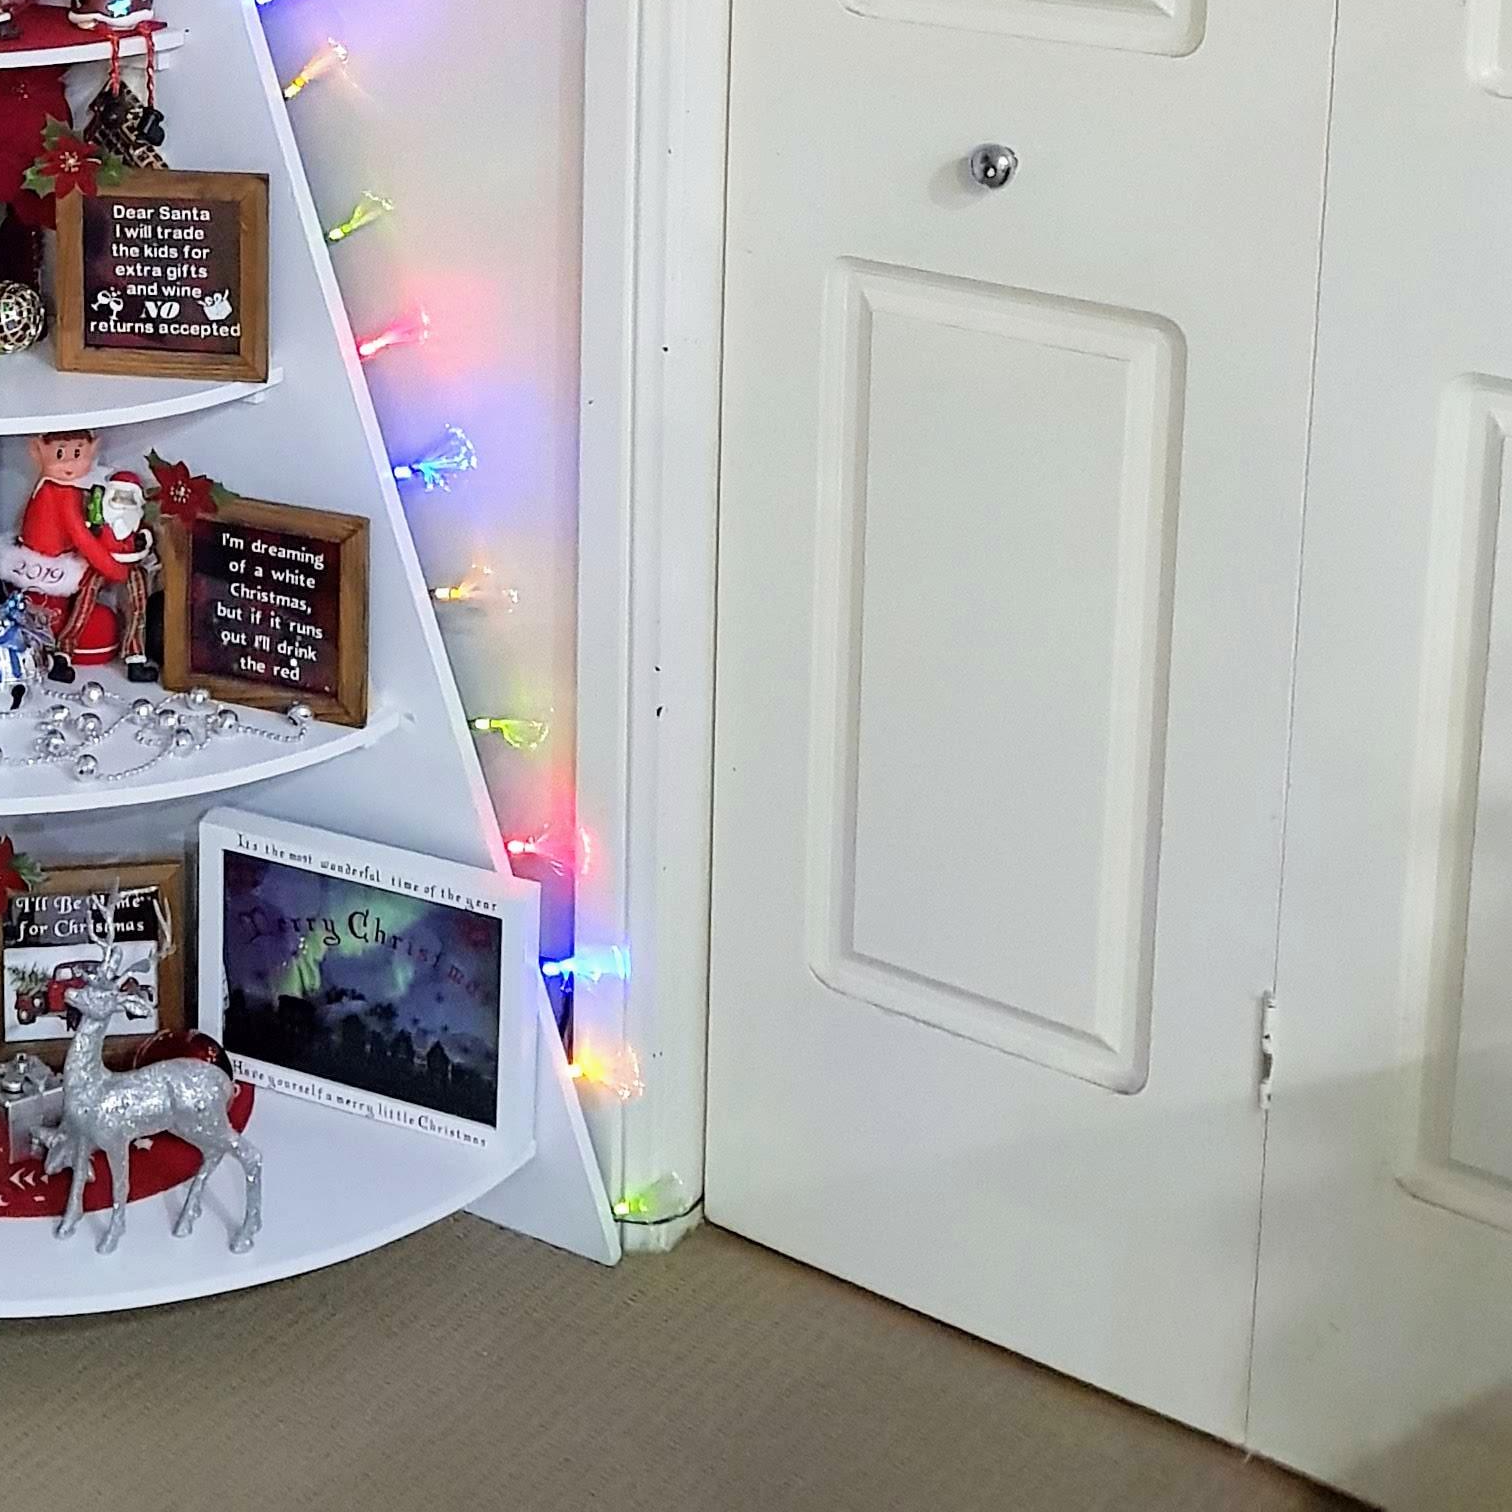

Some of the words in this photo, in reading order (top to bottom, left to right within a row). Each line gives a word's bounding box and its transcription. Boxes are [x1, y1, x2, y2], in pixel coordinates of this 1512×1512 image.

[113, 205, 155, 219] Dear
[159, 206, 210, 221] Santa
[115, 224, 120, 238] I
[125, 223, 152, 239] will
[157, 226, 204, 239] trade
[112, 244, 139, 257] the
[144, 243, 178, 259] kids
[183, 245, 210, 259] for
[115, 264, 162, 277] extra
[166, 264, 208, 280] gifts
[126, 283, 157, 296] and
[162, 284, 202, 298] wine
[140, 301, 180, 319] NO
[90, 320, 154, 334] returns
[158, 323, 241, 338] accepted
[222, 533, 244, 550] I'm
[251, 539, 324, 570] dreaming
[13, 560, 64, 584] 2019
[229, 559, 247, 572] of
[254, 566, 263, 577] a
[271, 569, 316, 589] white
[230, 583, 311, 614] Christmas,
[217, 602, 242, 620] but
[250, 608, 262, 625] if
[270, 611, 281, 629] it
[289, 621, 323, 639] runs
[221, 630, 247, 645] out
[254, 635, 270, 651] I'll
[277, 640, 317, 661] drink
[240, 656, 266, 673] the
[273, 665, 300, 681] red
[265, 844, 285, 859] the
[289, 851, 312, 864] most
[391, 876, 419, 892] time
[424, 885, 436, 898] of
[441, 888, 462, 902] the
[466, 897, 497, 912] year
[53, 896, 82, 914] Be
[88, 893, 141, 910] Hme
[17, 921, 48, 942] for
[378, 1103, 415, 1125] little
[418, 1115, 486, 1147] Christmas
